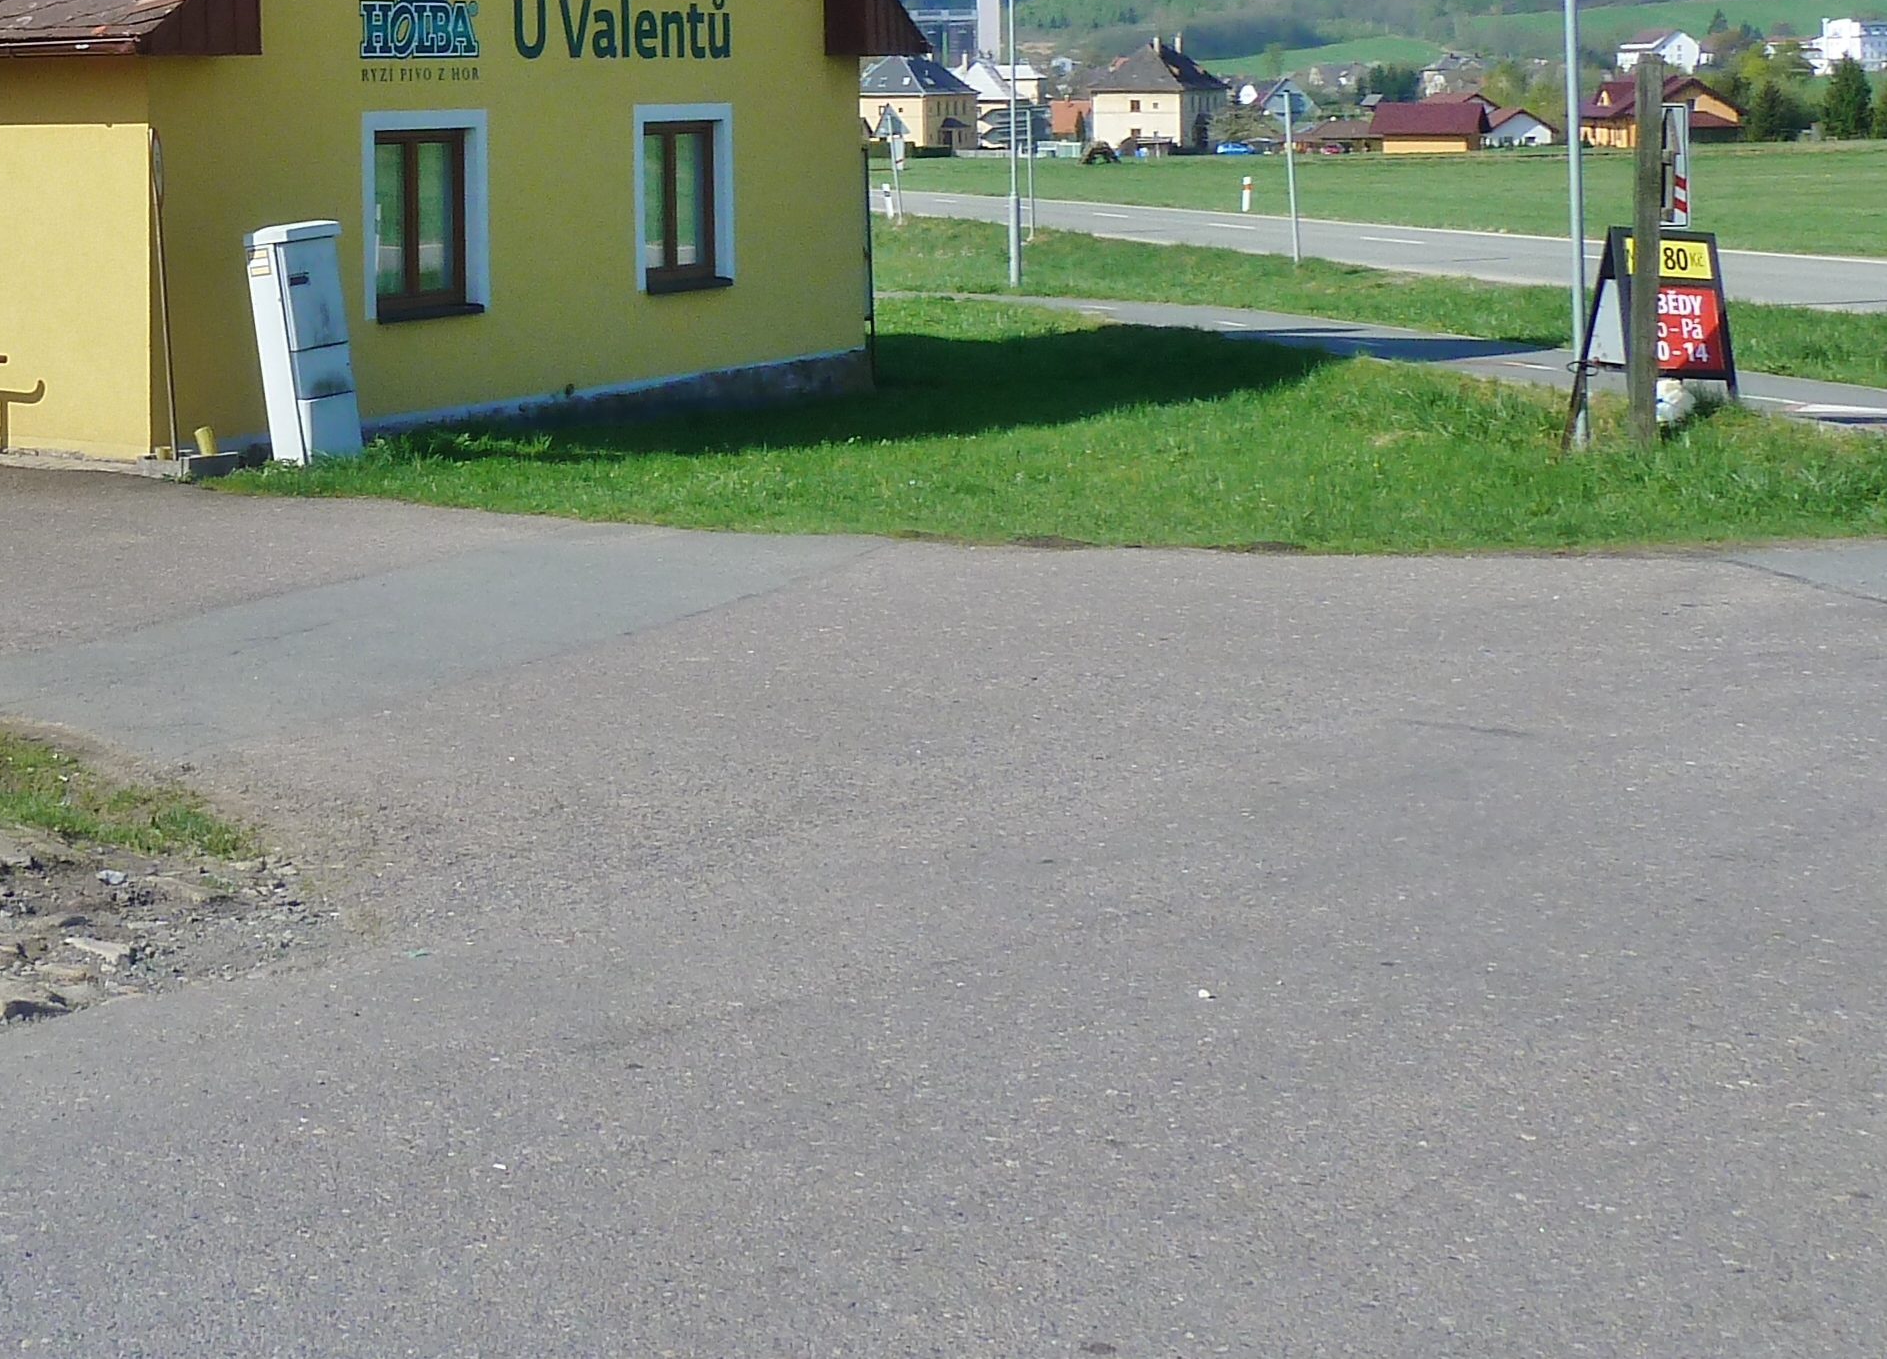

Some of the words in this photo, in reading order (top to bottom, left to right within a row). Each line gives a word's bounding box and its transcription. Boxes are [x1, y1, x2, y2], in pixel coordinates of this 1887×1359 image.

[359, 0, 479, 59] HOLBA
[437, 68, 446, 81] Z
[451, 67, 480, 81] HOR
[1663, 247, 1689, 271] 80
[1657, 289, 1704, 316] BĚDY
[1681, 318, 1705, 339] Pá
[1683, 342, 1709, 363] 14
